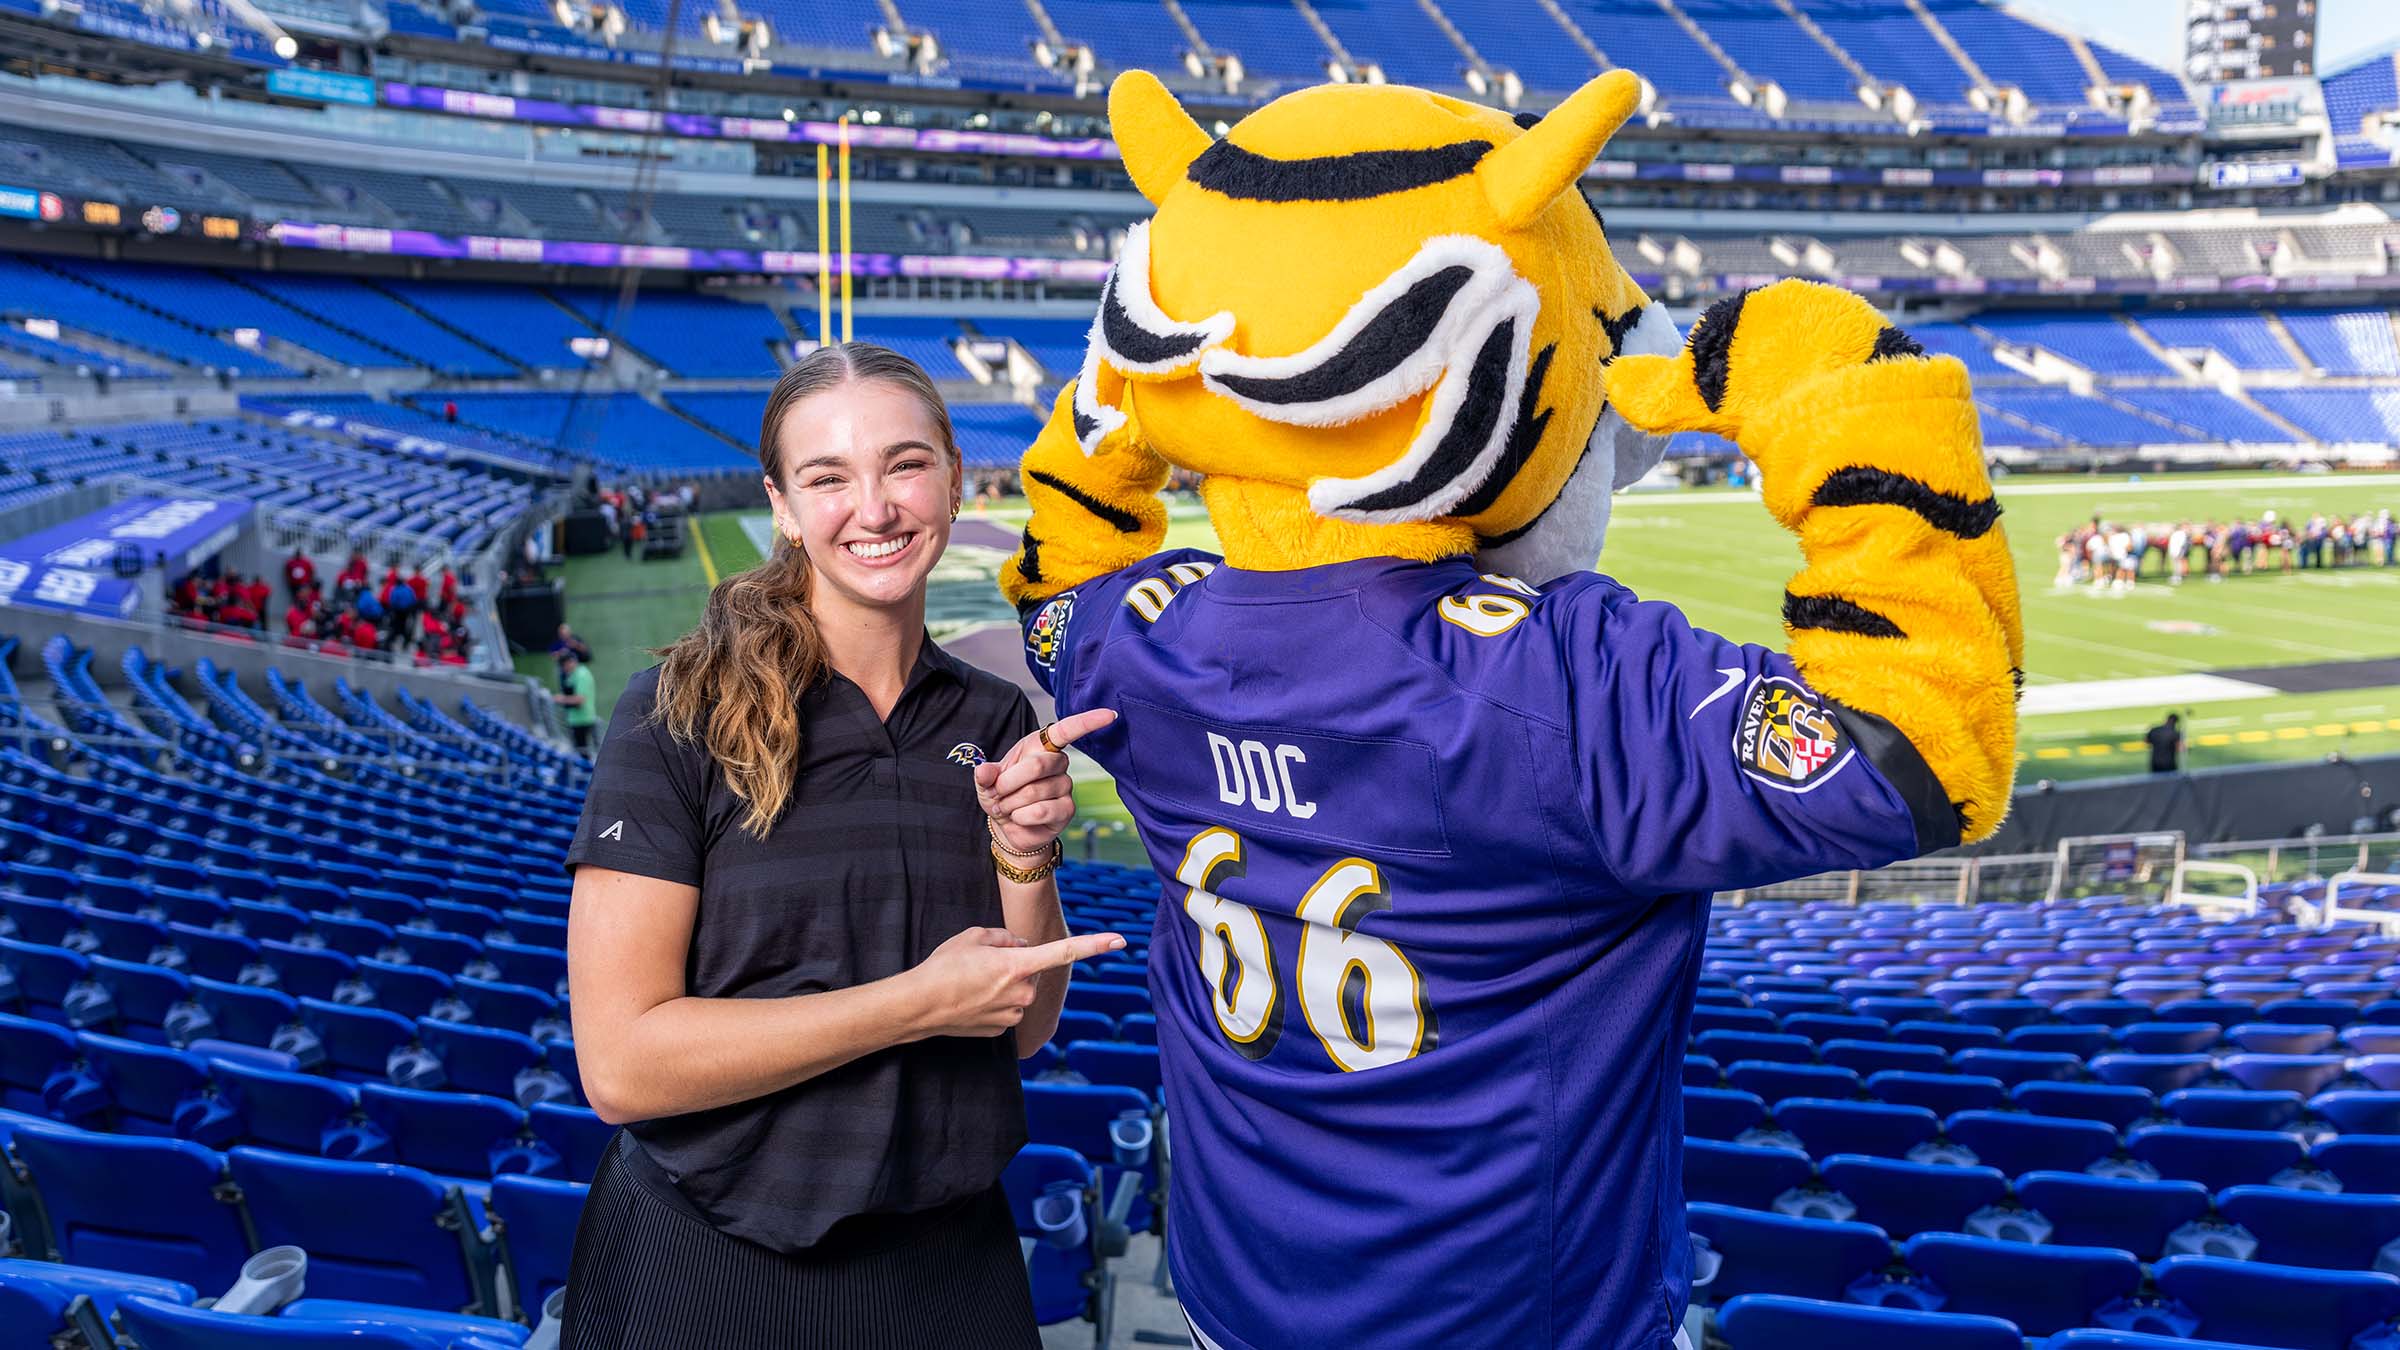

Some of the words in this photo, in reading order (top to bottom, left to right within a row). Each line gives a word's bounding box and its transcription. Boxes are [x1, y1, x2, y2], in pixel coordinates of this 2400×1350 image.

[1050, 599, 1072, 661] RAVENS
[1742, 688, 1767, 762] RAVEN
[1206, 731, 1317, 819] DOC
[1176, 825, 1440, 1073] 66
